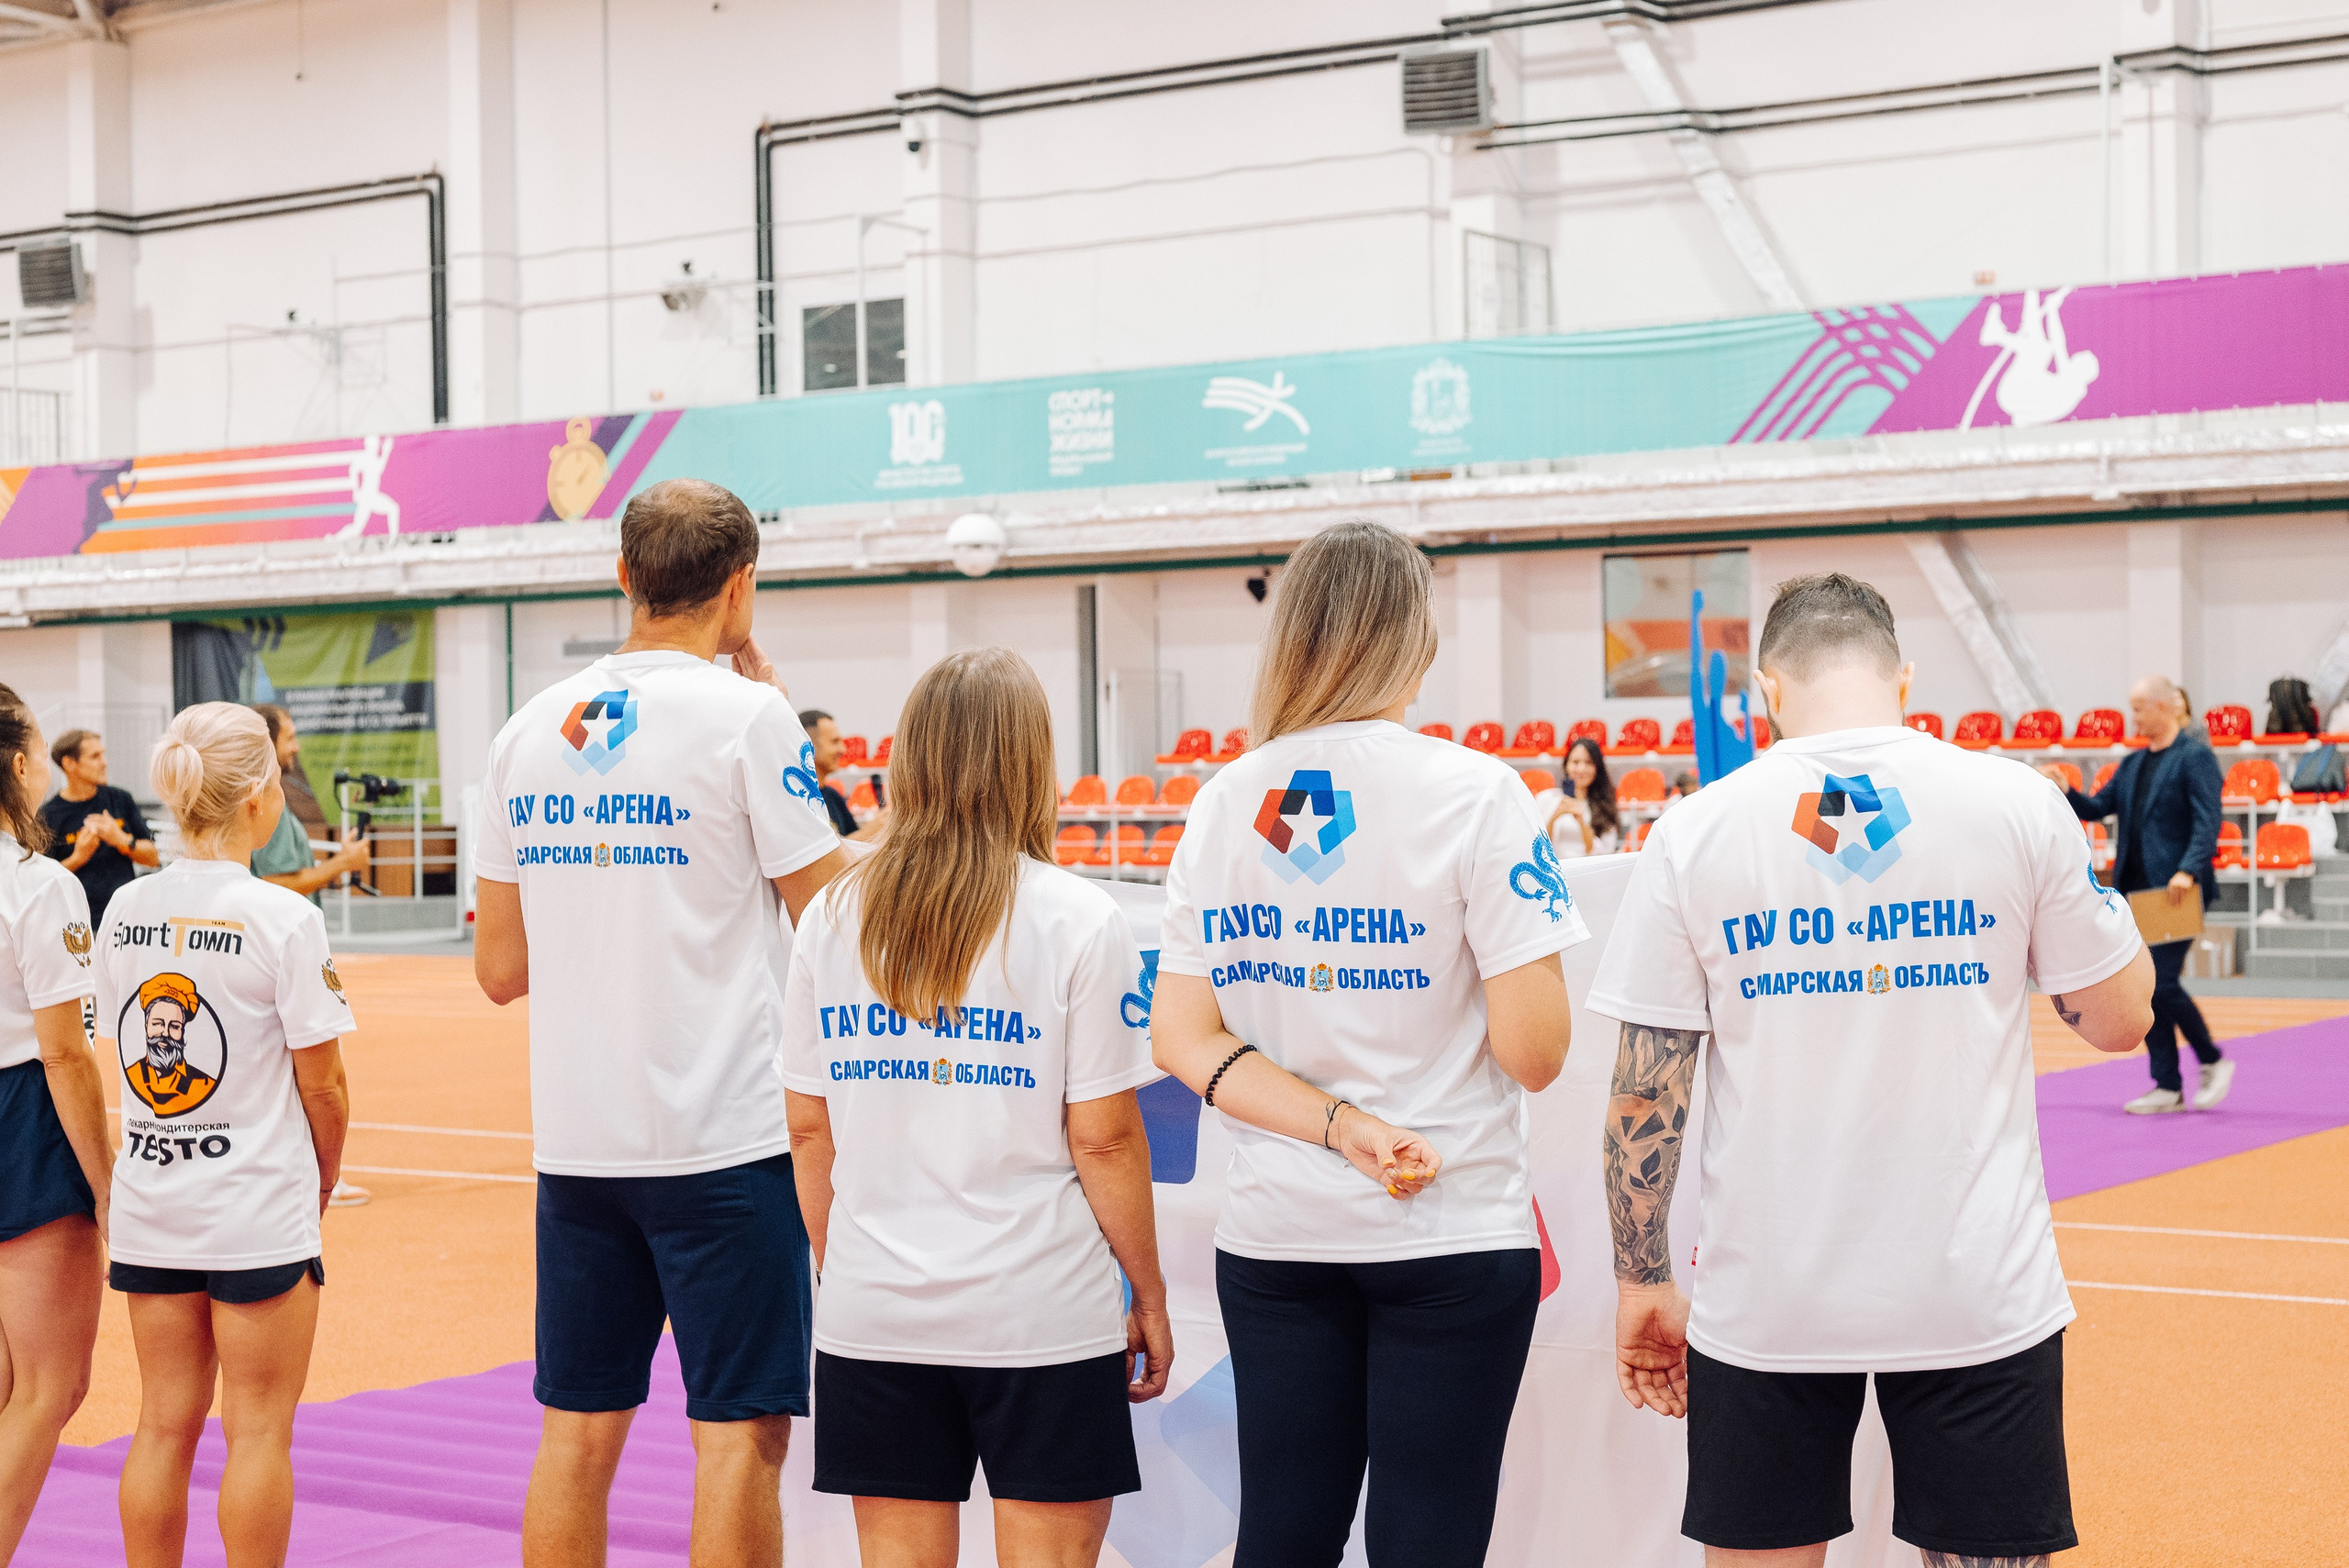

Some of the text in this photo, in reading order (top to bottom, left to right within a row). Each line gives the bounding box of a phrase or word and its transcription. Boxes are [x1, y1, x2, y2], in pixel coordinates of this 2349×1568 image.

[508, 794, 691, 827] ГАУ СО «АРЕНА»
[518, 846, 689, 866] САРСКАЯ ОБЛАСТЬ
[1295, 906, 1426, 944] «АРЕНА»
[1721, 899, 1997, 955] ГАУ СО «АРЕНА»
[1338, 968, 1431, 990] ОБЛАСТЬ
[1740, 962, 1989, 999] СМАРСКАЯ ОБЛАСТЬ
[819, 1005, 861, 1039] ГАУ
[867, 1003, 907, 1036] СО
[830, 1059, 1036, 1088] СААРСКАЯ ОБЛАСТЬ
